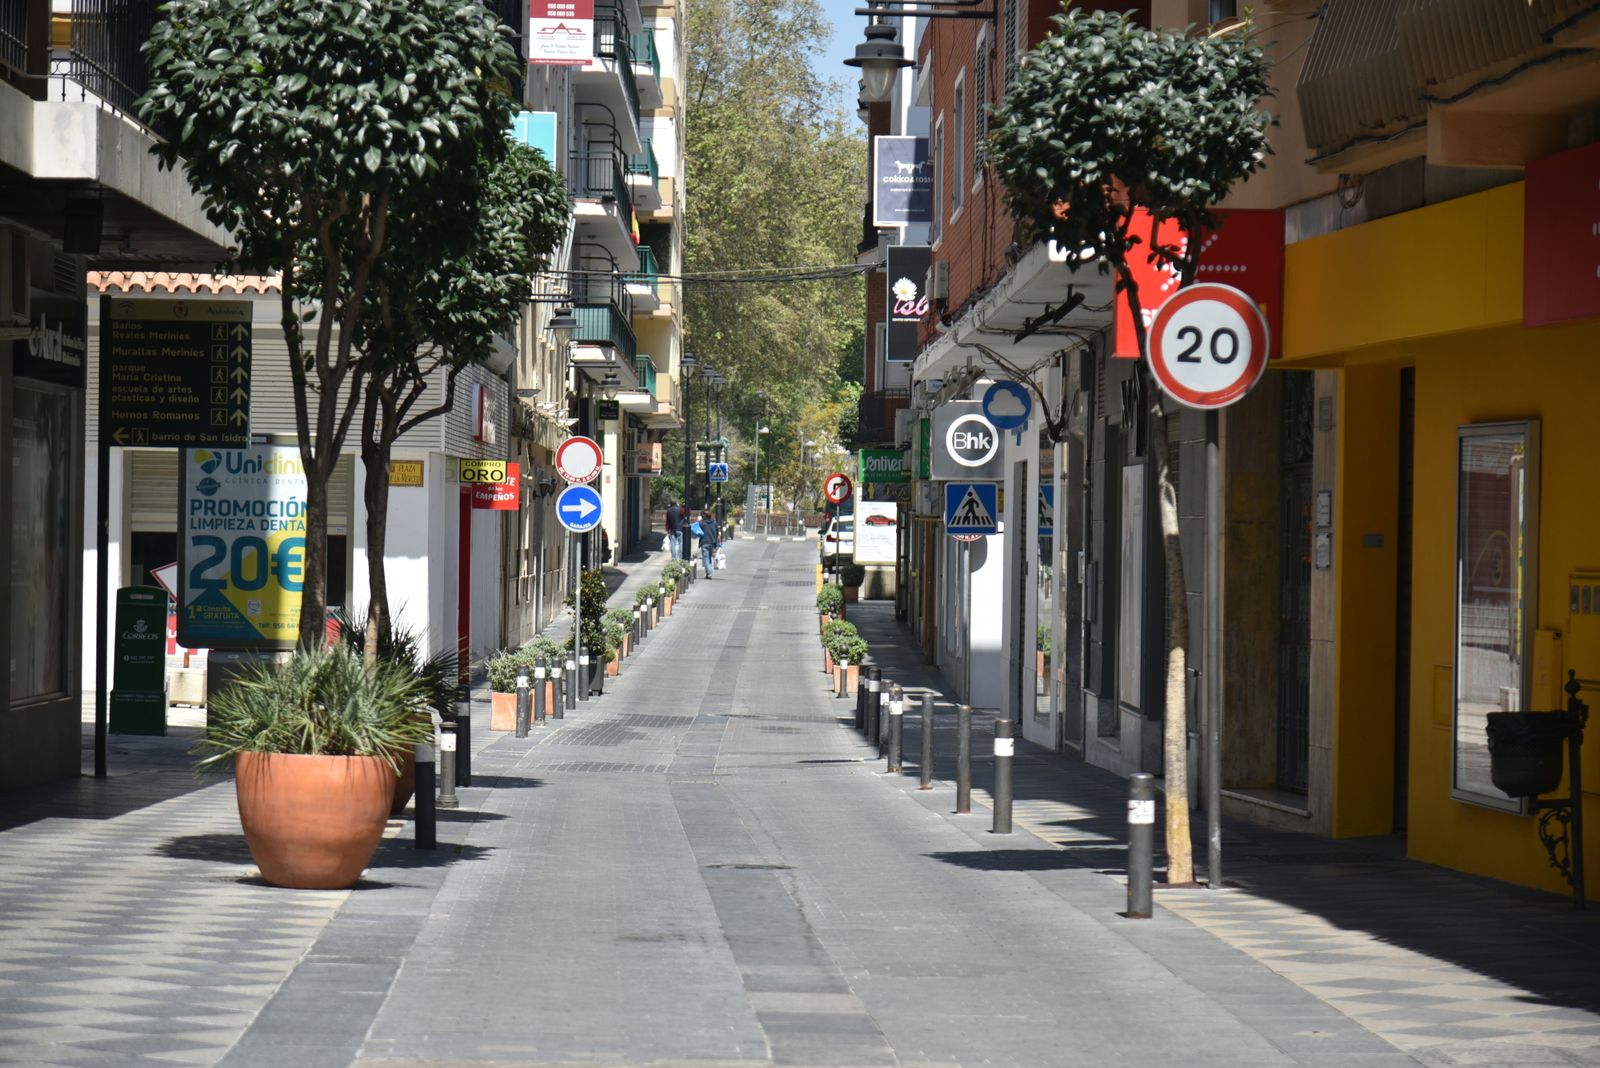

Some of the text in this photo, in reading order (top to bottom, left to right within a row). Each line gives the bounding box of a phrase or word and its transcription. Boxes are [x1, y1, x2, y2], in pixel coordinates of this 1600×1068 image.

[112, 322, 143, 331] Baños
[112, 331, 145, 340] Reales
[1177, 325, 1240, 364] 20
[112, 347, 157, 357] Murallas
[112, 364, 146, 374] parque
[143, 373, 183, 383] Cristina
[112, 386, 193, 395] escuela de artes
[159, 397, 166, 406] y
[168, 395, 200, 405] diseño
[112, 410, 201, 421] Hornos Romanos
[152, 431, 249, 443] barrio de San Isidro
[954, 432, 990, 449] Bhk
[226, 450, 306, 474] Uniclini
[462, 468, 504, 482] ORO
[476, 492, 514, 501] EMPEÑOS
[190, 519, 306, 531] LIMPIEZA DENTA
[189, 535, 306, 592] 20€
[203, 612, 239, 620] GRATUITA
[122, 632, 158, 640] CORREOS
